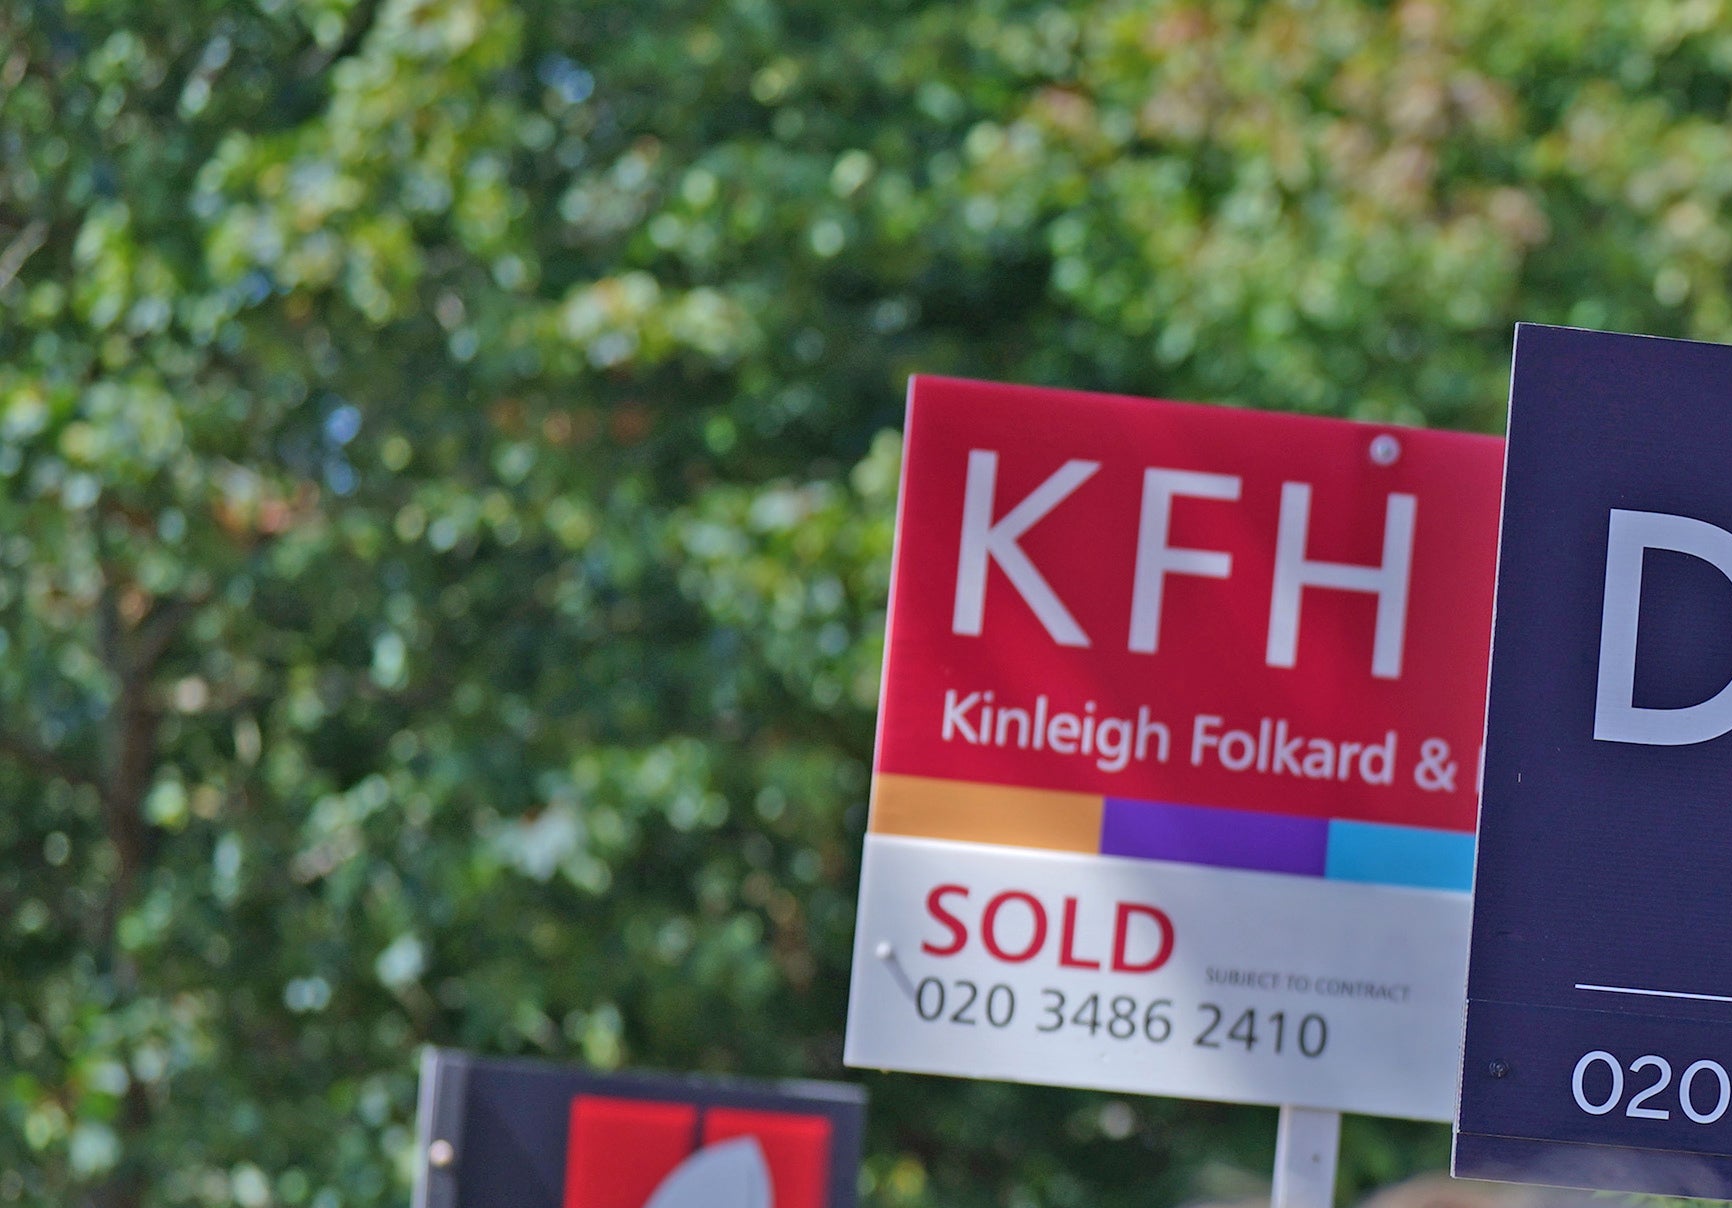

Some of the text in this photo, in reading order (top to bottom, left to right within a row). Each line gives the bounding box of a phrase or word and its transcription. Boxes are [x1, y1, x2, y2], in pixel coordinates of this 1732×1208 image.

[952, 448, 1417, 680] KFH
[941, 688, 1170, 773] Kinleigh
[1190, 714, 1397, 786] Folkard
[1413, 736, 1458, 793] &
[920, 883, 1176, 975] SOLD
[914, 976, 1329, 1060] 020 3486 2410
[1205, 966, 1412, 1002] SUBJECT TO CONTRACT
[1571, 1049, 1732, 1126] 020
